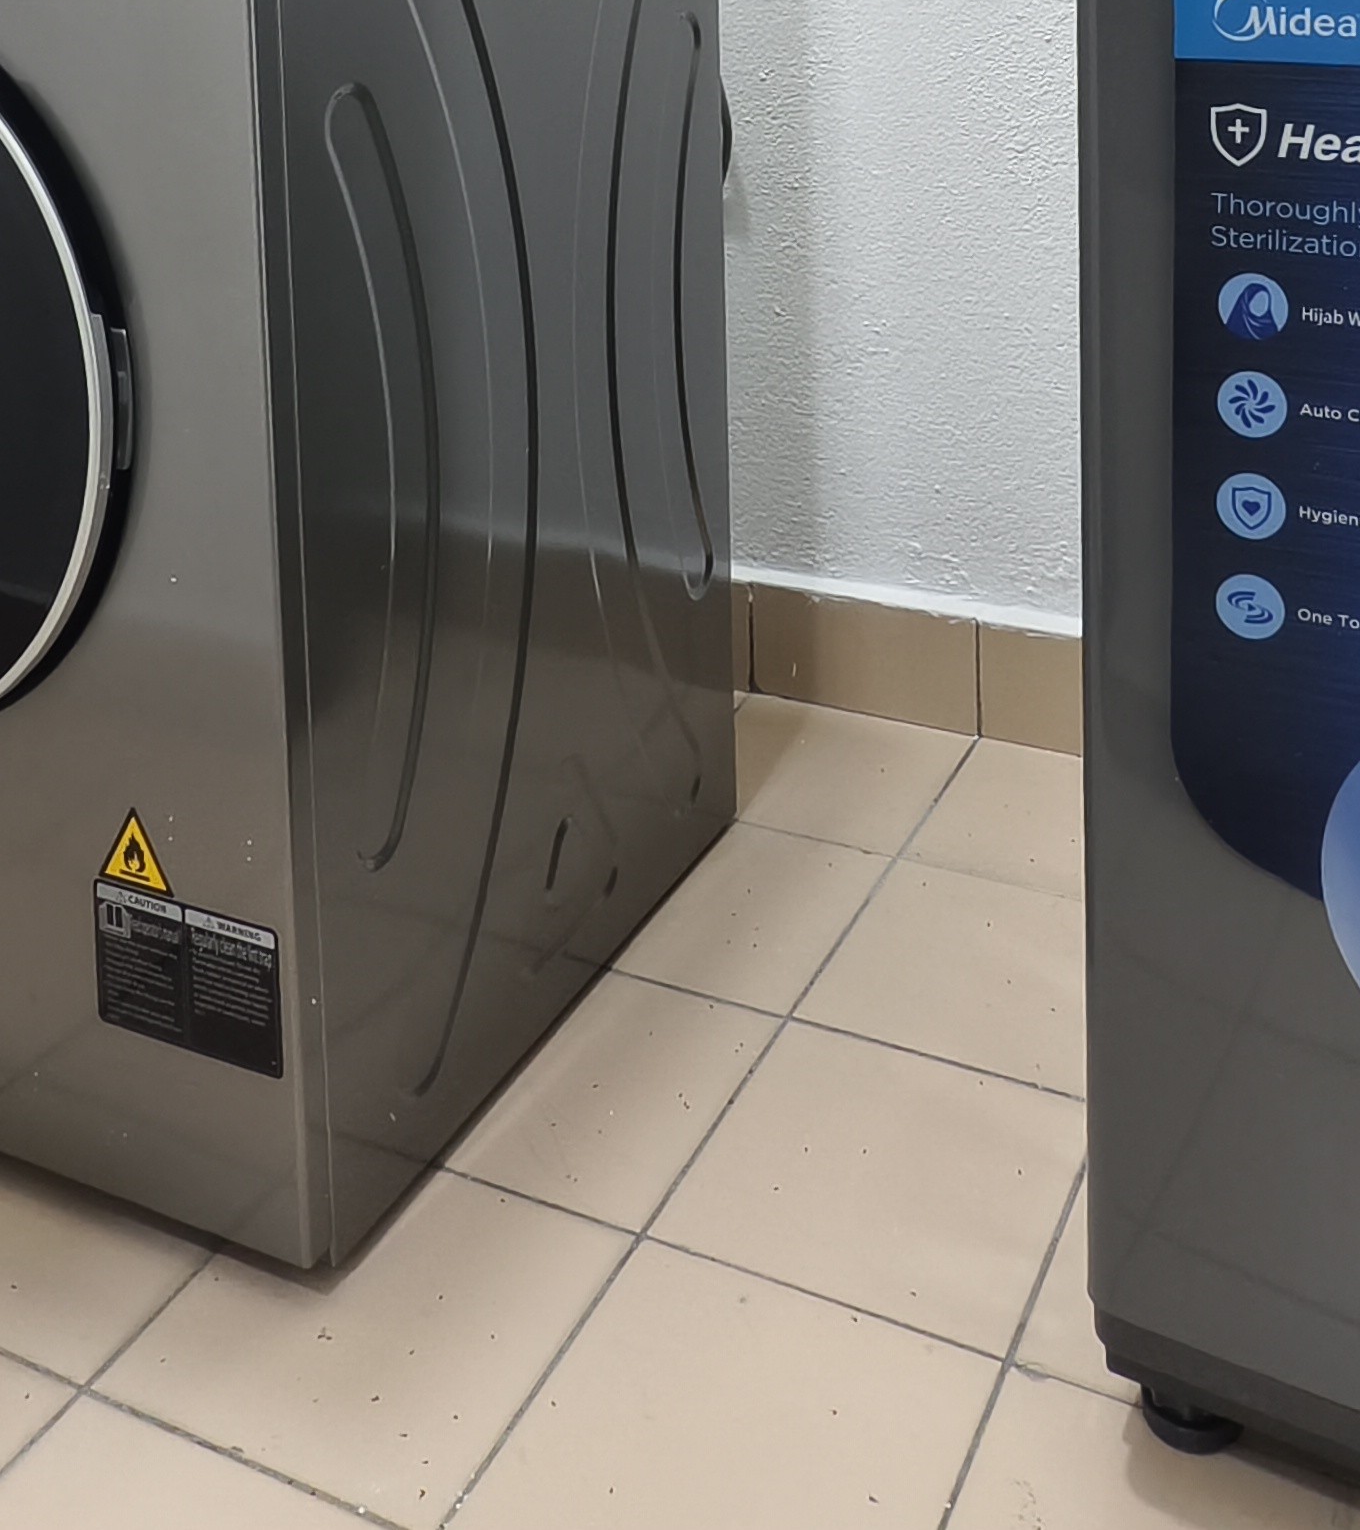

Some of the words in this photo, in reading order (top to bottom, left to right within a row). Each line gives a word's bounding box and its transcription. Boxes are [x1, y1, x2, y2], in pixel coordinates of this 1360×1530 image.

[1301, 306, 1344, 327] Hijab
[1299, 403, 1342, 421] Auto
[1297, 608, 1333, 625] One
[127, 894, 167, 914] CAUTION
